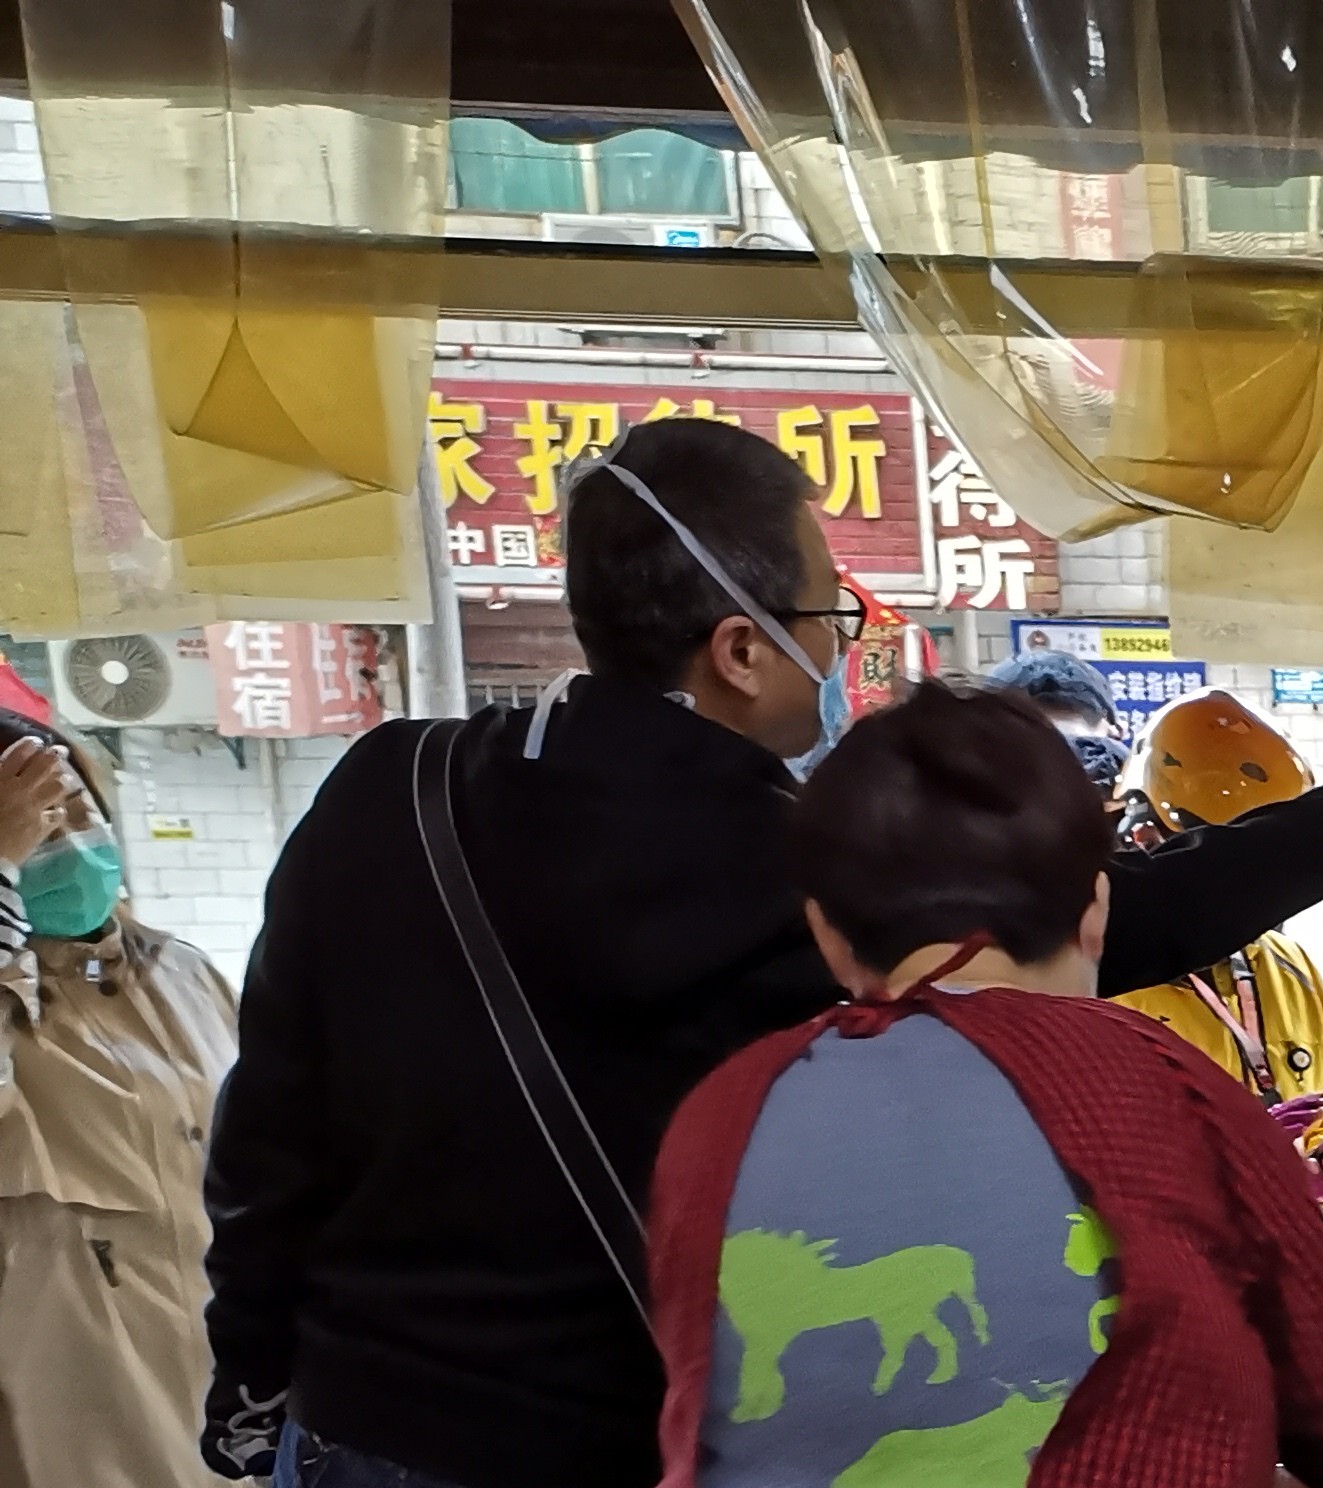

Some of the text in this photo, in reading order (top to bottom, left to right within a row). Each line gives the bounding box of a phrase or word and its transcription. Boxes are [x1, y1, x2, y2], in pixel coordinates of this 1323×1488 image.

[428, 392, 887, 519] 家招所
[448, 521, 538, 567] 中国
[224, 621, 291, 730] 住宿
